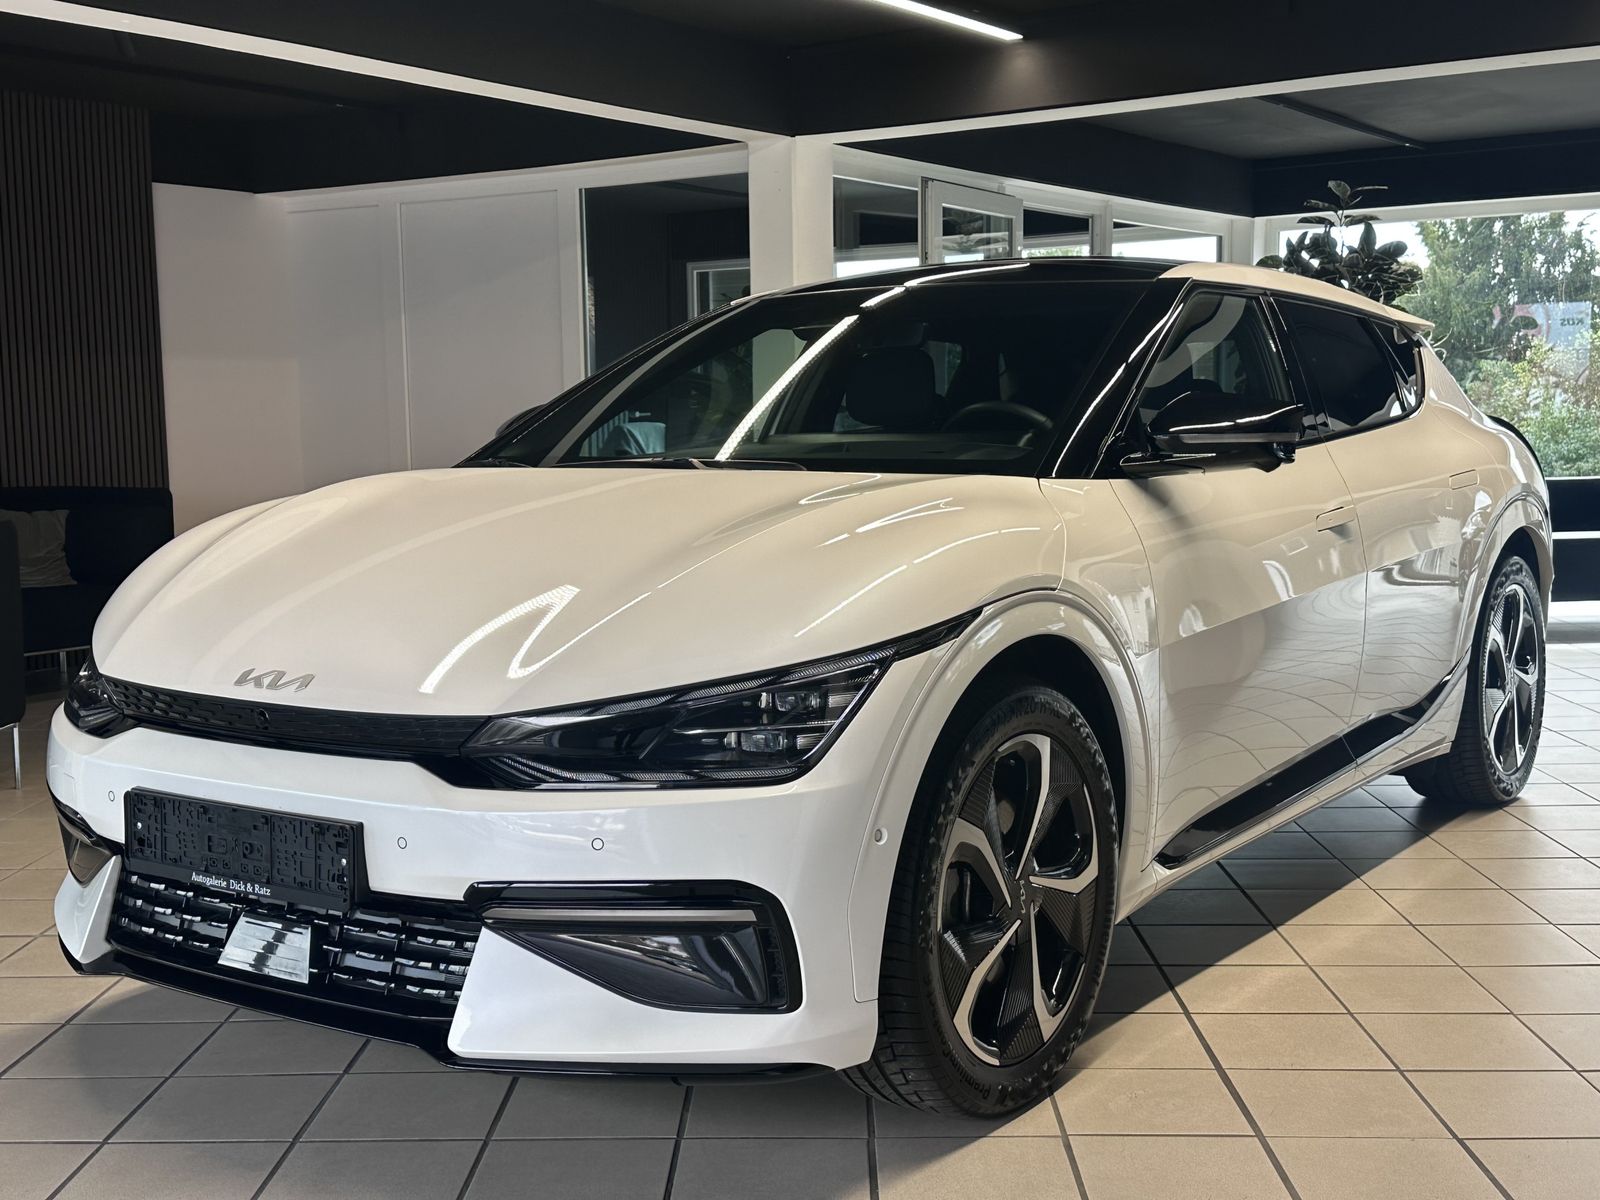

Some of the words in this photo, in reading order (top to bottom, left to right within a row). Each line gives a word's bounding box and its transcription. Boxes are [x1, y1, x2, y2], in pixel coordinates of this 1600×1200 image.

[233, 667, 315, 692] KIA
[192, 871, 227, 888] Autogalerie
[229, 879, 246, 891] Dick
[246, 882, 253, 893] &
[254, 884, 271, 896] Ratz
